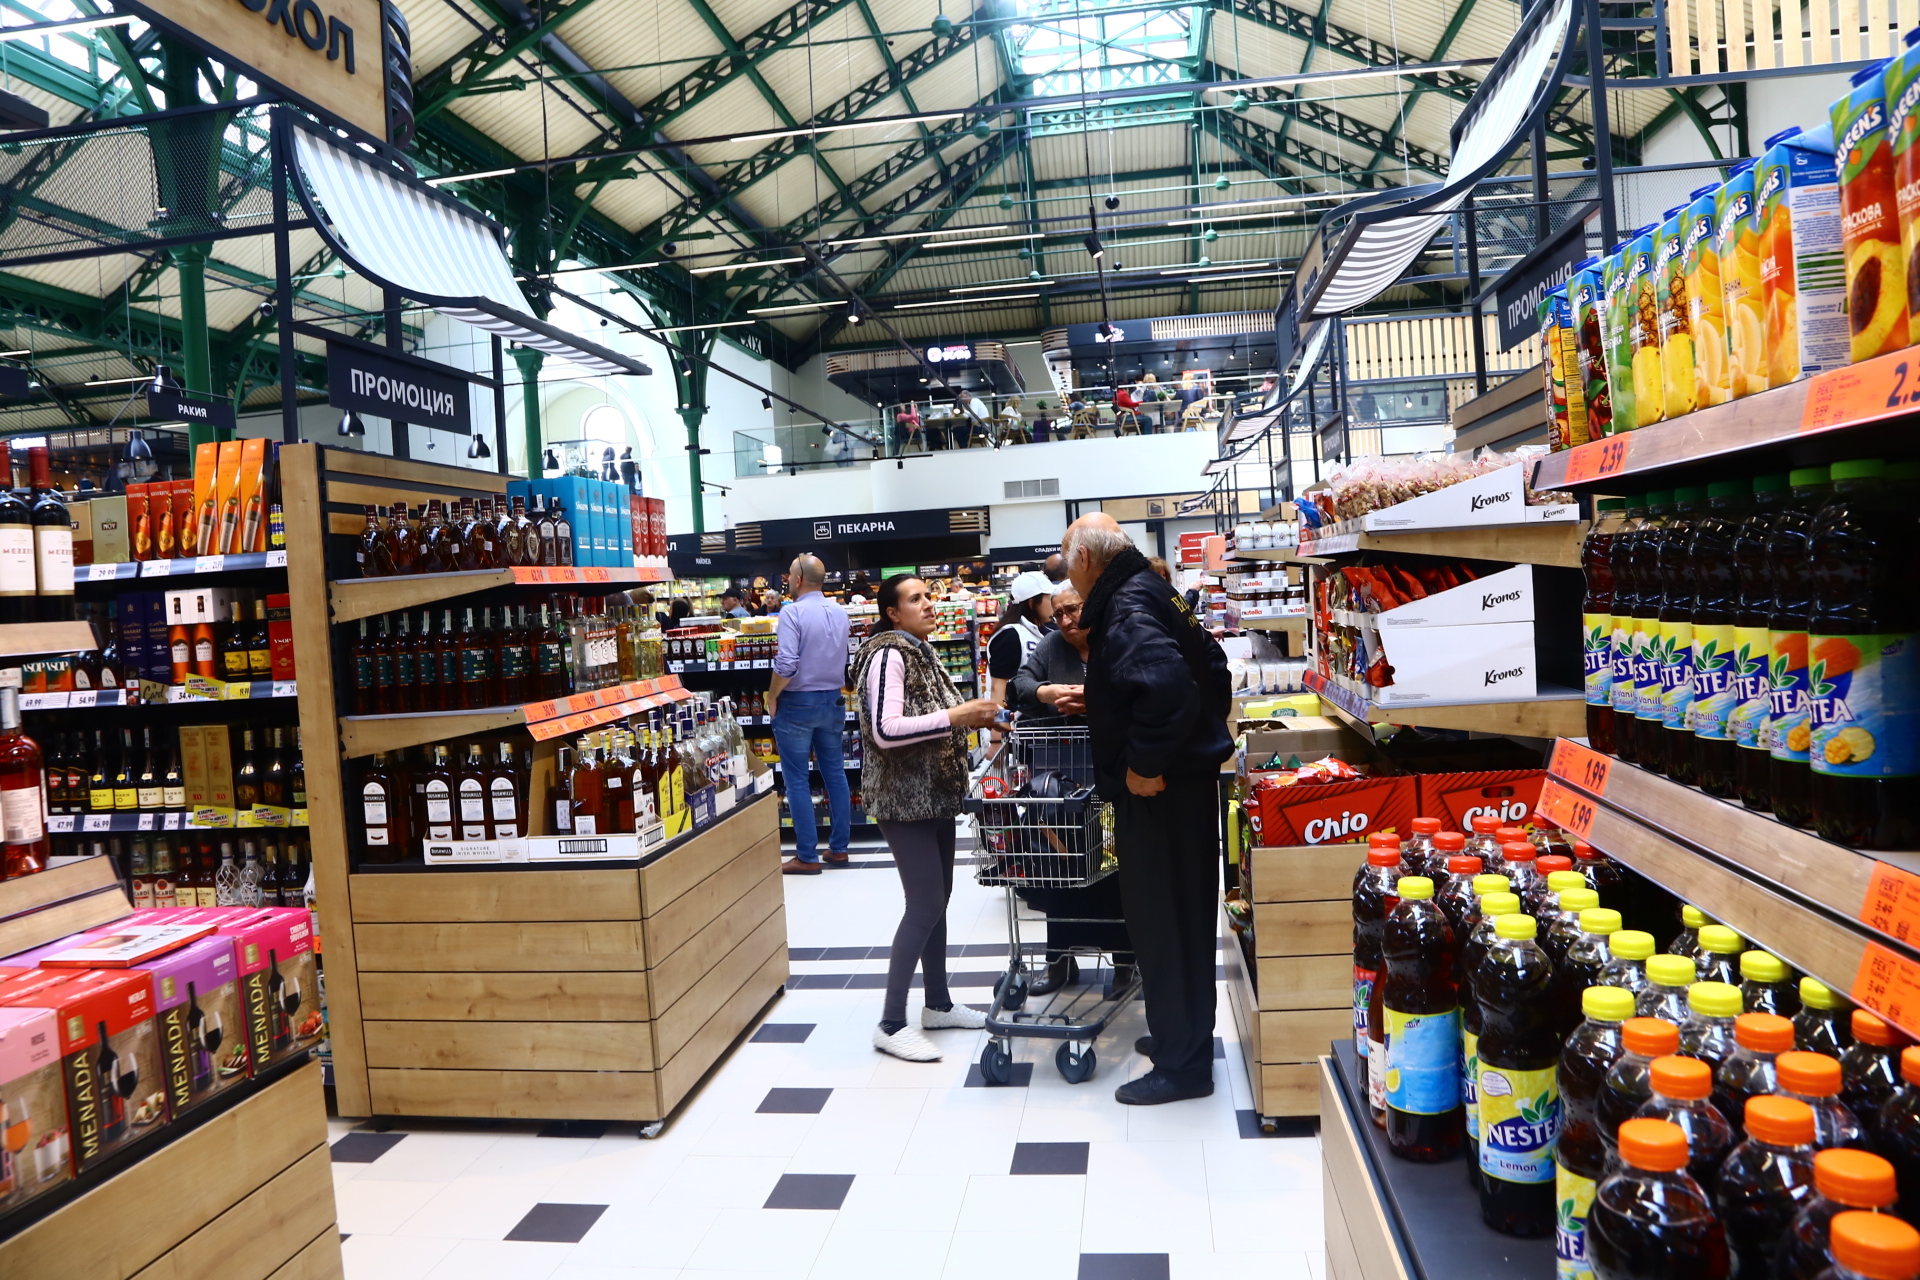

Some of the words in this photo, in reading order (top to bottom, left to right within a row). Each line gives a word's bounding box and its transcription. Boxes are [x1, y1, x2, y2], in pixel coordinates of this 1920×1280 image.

[240, 0, 355, 75] ХОЛ
[1835, 105, 1882, 177] QUEEN'S
[351, 368, 455, 417] ПРОМОЦИЯ
[178, 404, 207, 418] РАКИЯ
[1599, 441, 1624, 473] 2.39
[1471, 491, 1511, 512] Kronos
[1543, 508, 1565, 520] Kronos
[838, 521, 895, 534] ПЕКАРНА
[277, 556, 287, 564] 17.
[1482, 590, 1521, 611] Kronos
[1484, 666, 1523, 687] Kronos
[1634, 660, 1661, 682] EST
[26, 699, 42, 707] 69.99
[79, 696, 95, 704] 54.99
[1583, 758, 1606, 790] 1.99
[57, 821, 73, 829] 47.99
[93, 820, 109, 828] 46.99
[1462, 799, 1527, 834] Chio
[1569, 801, 1592, 833] 1.99
[1304, 811, 1368, 844] Chio
[290, 921, 307, 935] CABERNET
[290, 929, 309, 943] SAUVIGNON
[128, 989, 147, 1005] MERLOT
[250, 974, 270, 1064] MENADA
[166, 1009, 190, 1107] MENADA
[73, 1051, 99, 1159] MENADA
[1487, 1119, 1563, 1147] NESTEA
[1500, 1160, 1538, 1173] Lemon
